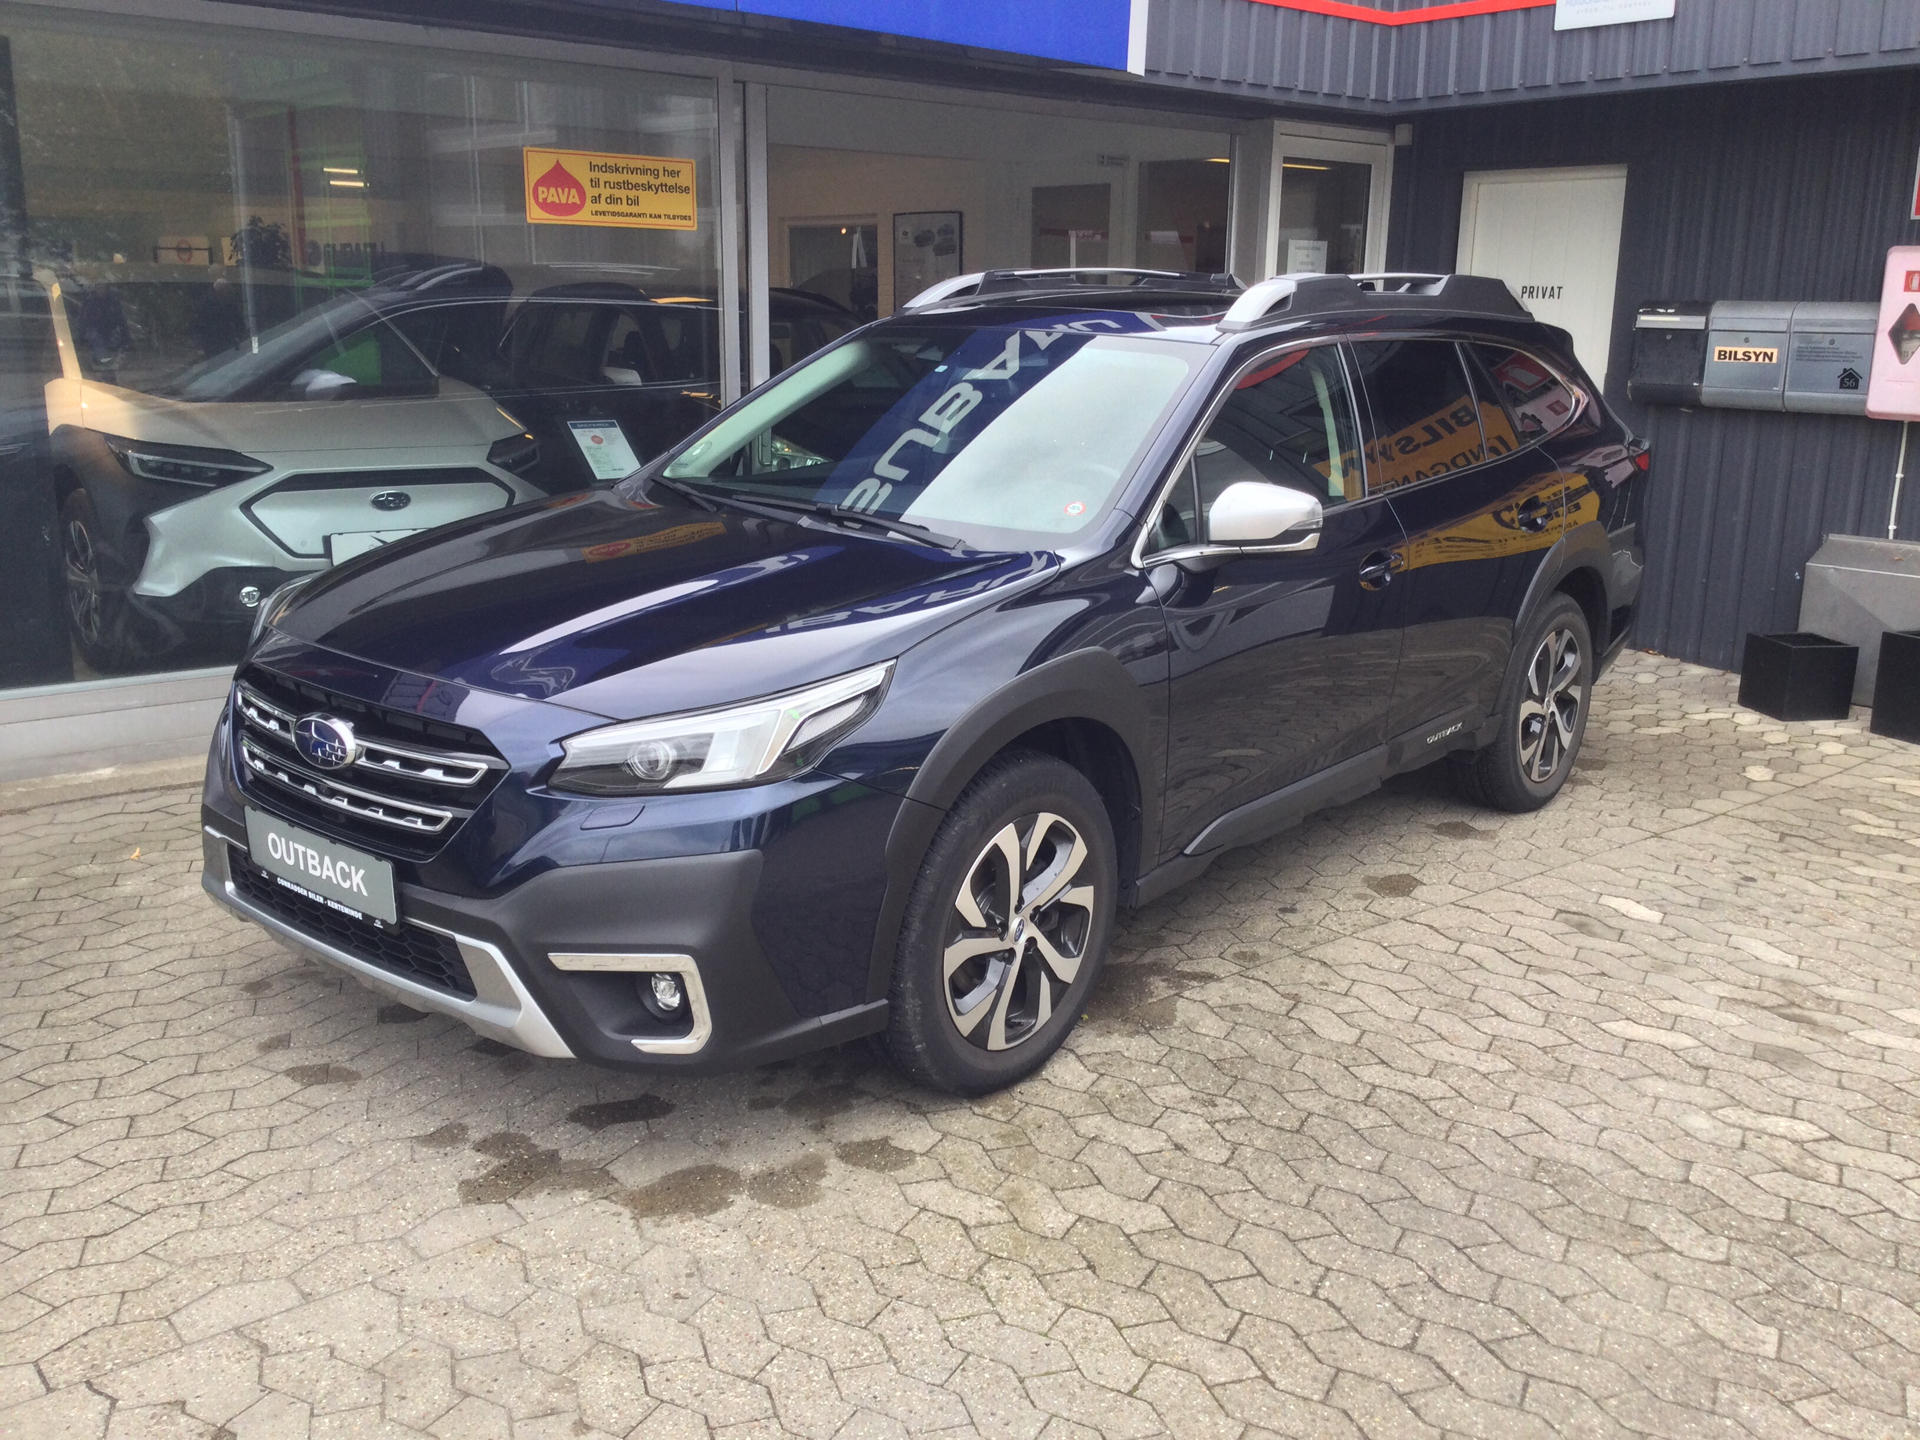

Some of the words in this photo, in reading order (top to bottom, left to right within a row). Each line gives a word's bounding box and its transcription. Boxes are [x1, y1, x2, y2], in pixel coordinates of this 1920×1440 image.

[589, 161, 660, 179] Indskrivning
[662, 167, 681, 178] her
[589, 178, 601, 189] til
[603, 180, 691, 195] rustbeskyttelse
[537, 186, 581, 205] PAVA
[590, 194, 602, 205] af
[605, 194, 623, 206] din
[626, 195, 640, 207] bil
[590, 210, 648, 219] LEVETIDSGARANTI
[1521, 285, 1563, 300] PRIVAT
[1717, 350, 1774, 362] BILSYN
[1842, 378, 1856, 387] 56
[267, 832, 368, 897] OUTBACK
[308, 891, 324, 904] BILER
[327, 900, 363, 921] KERTEMINDE
